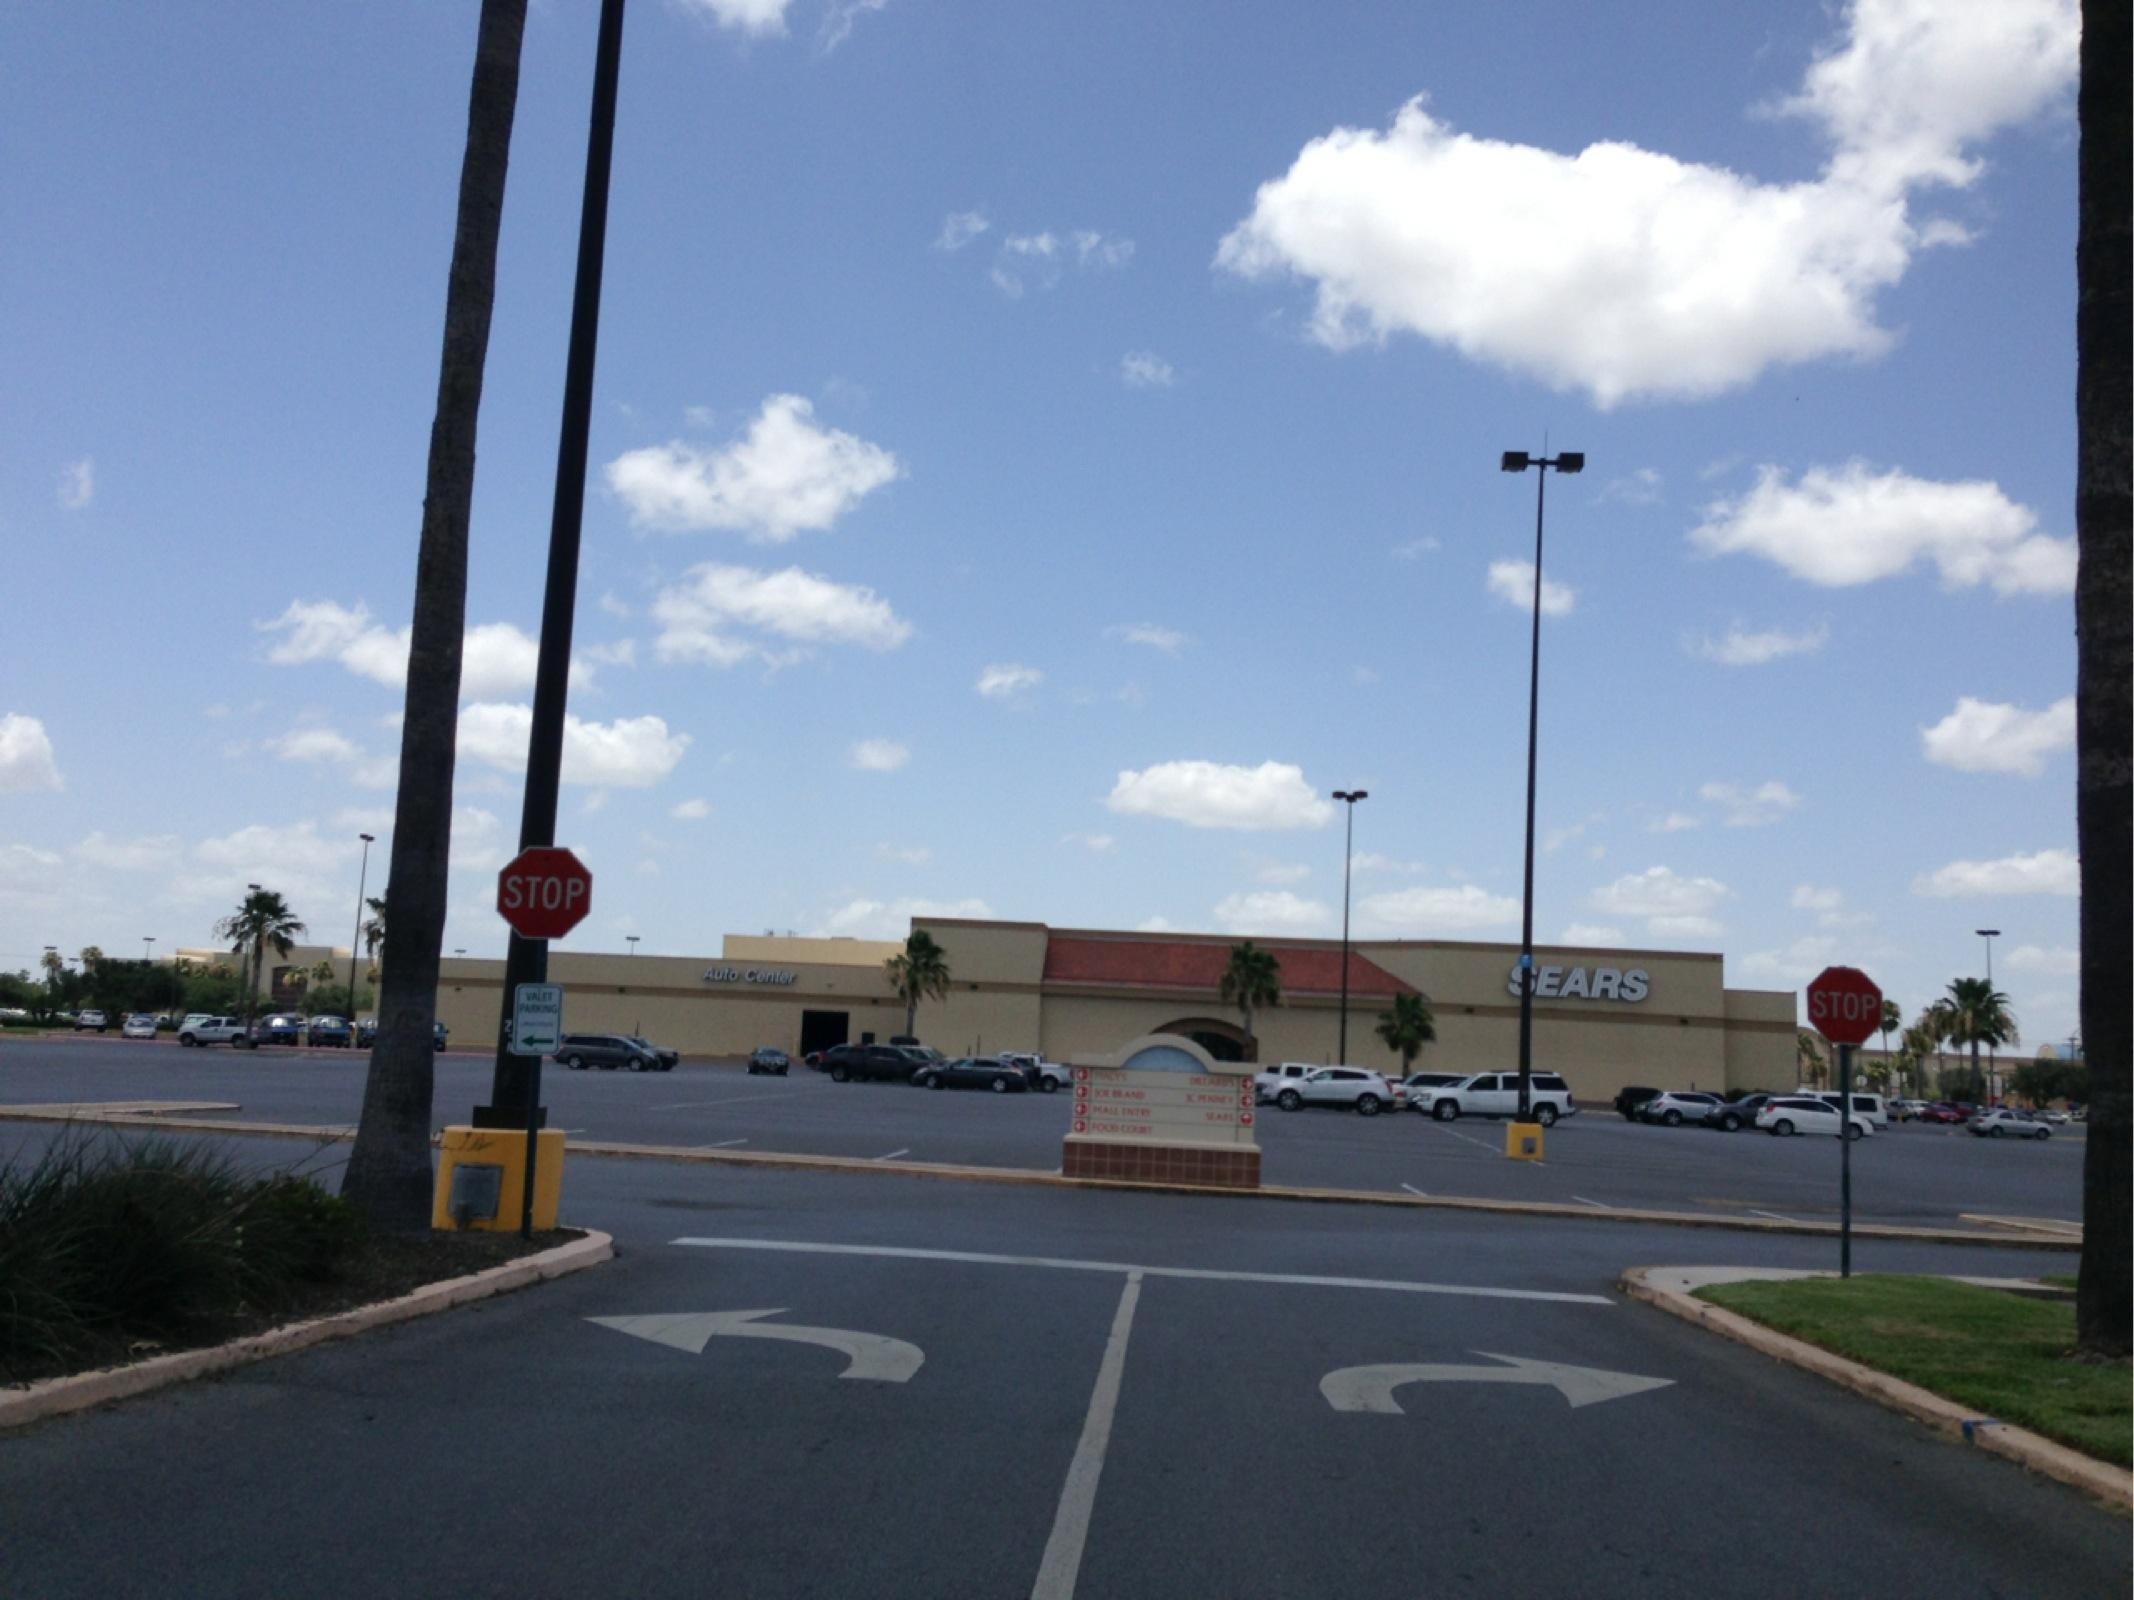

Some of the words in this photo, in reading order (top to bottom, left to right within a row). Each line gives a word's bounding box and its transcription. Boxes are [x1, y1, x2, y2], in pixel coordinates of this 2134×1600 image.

[504, 874, 586, 910] STOP
[703, 966, 738, 982] Auto
[745, 967, 798, 985] Center
[1507, 964, 1650, 1003] SEARS
[525, 991, 553, 1002] VALET
[519, 1003, 558, 1014] PARKING
[1813, 991, 1877, 1020] STOP
[1112, 1089, 1146, 1100] BRAND
[1092, 1104, 1119, 1115] MALL
[1121, 1106, 1152, 1117] ENTRY
[1204, 1112, 1234, 1123] SEARS
[1092, 1121, 1119, 1132] FOOD
[1121, 1123, 1152, 1135] COURT
